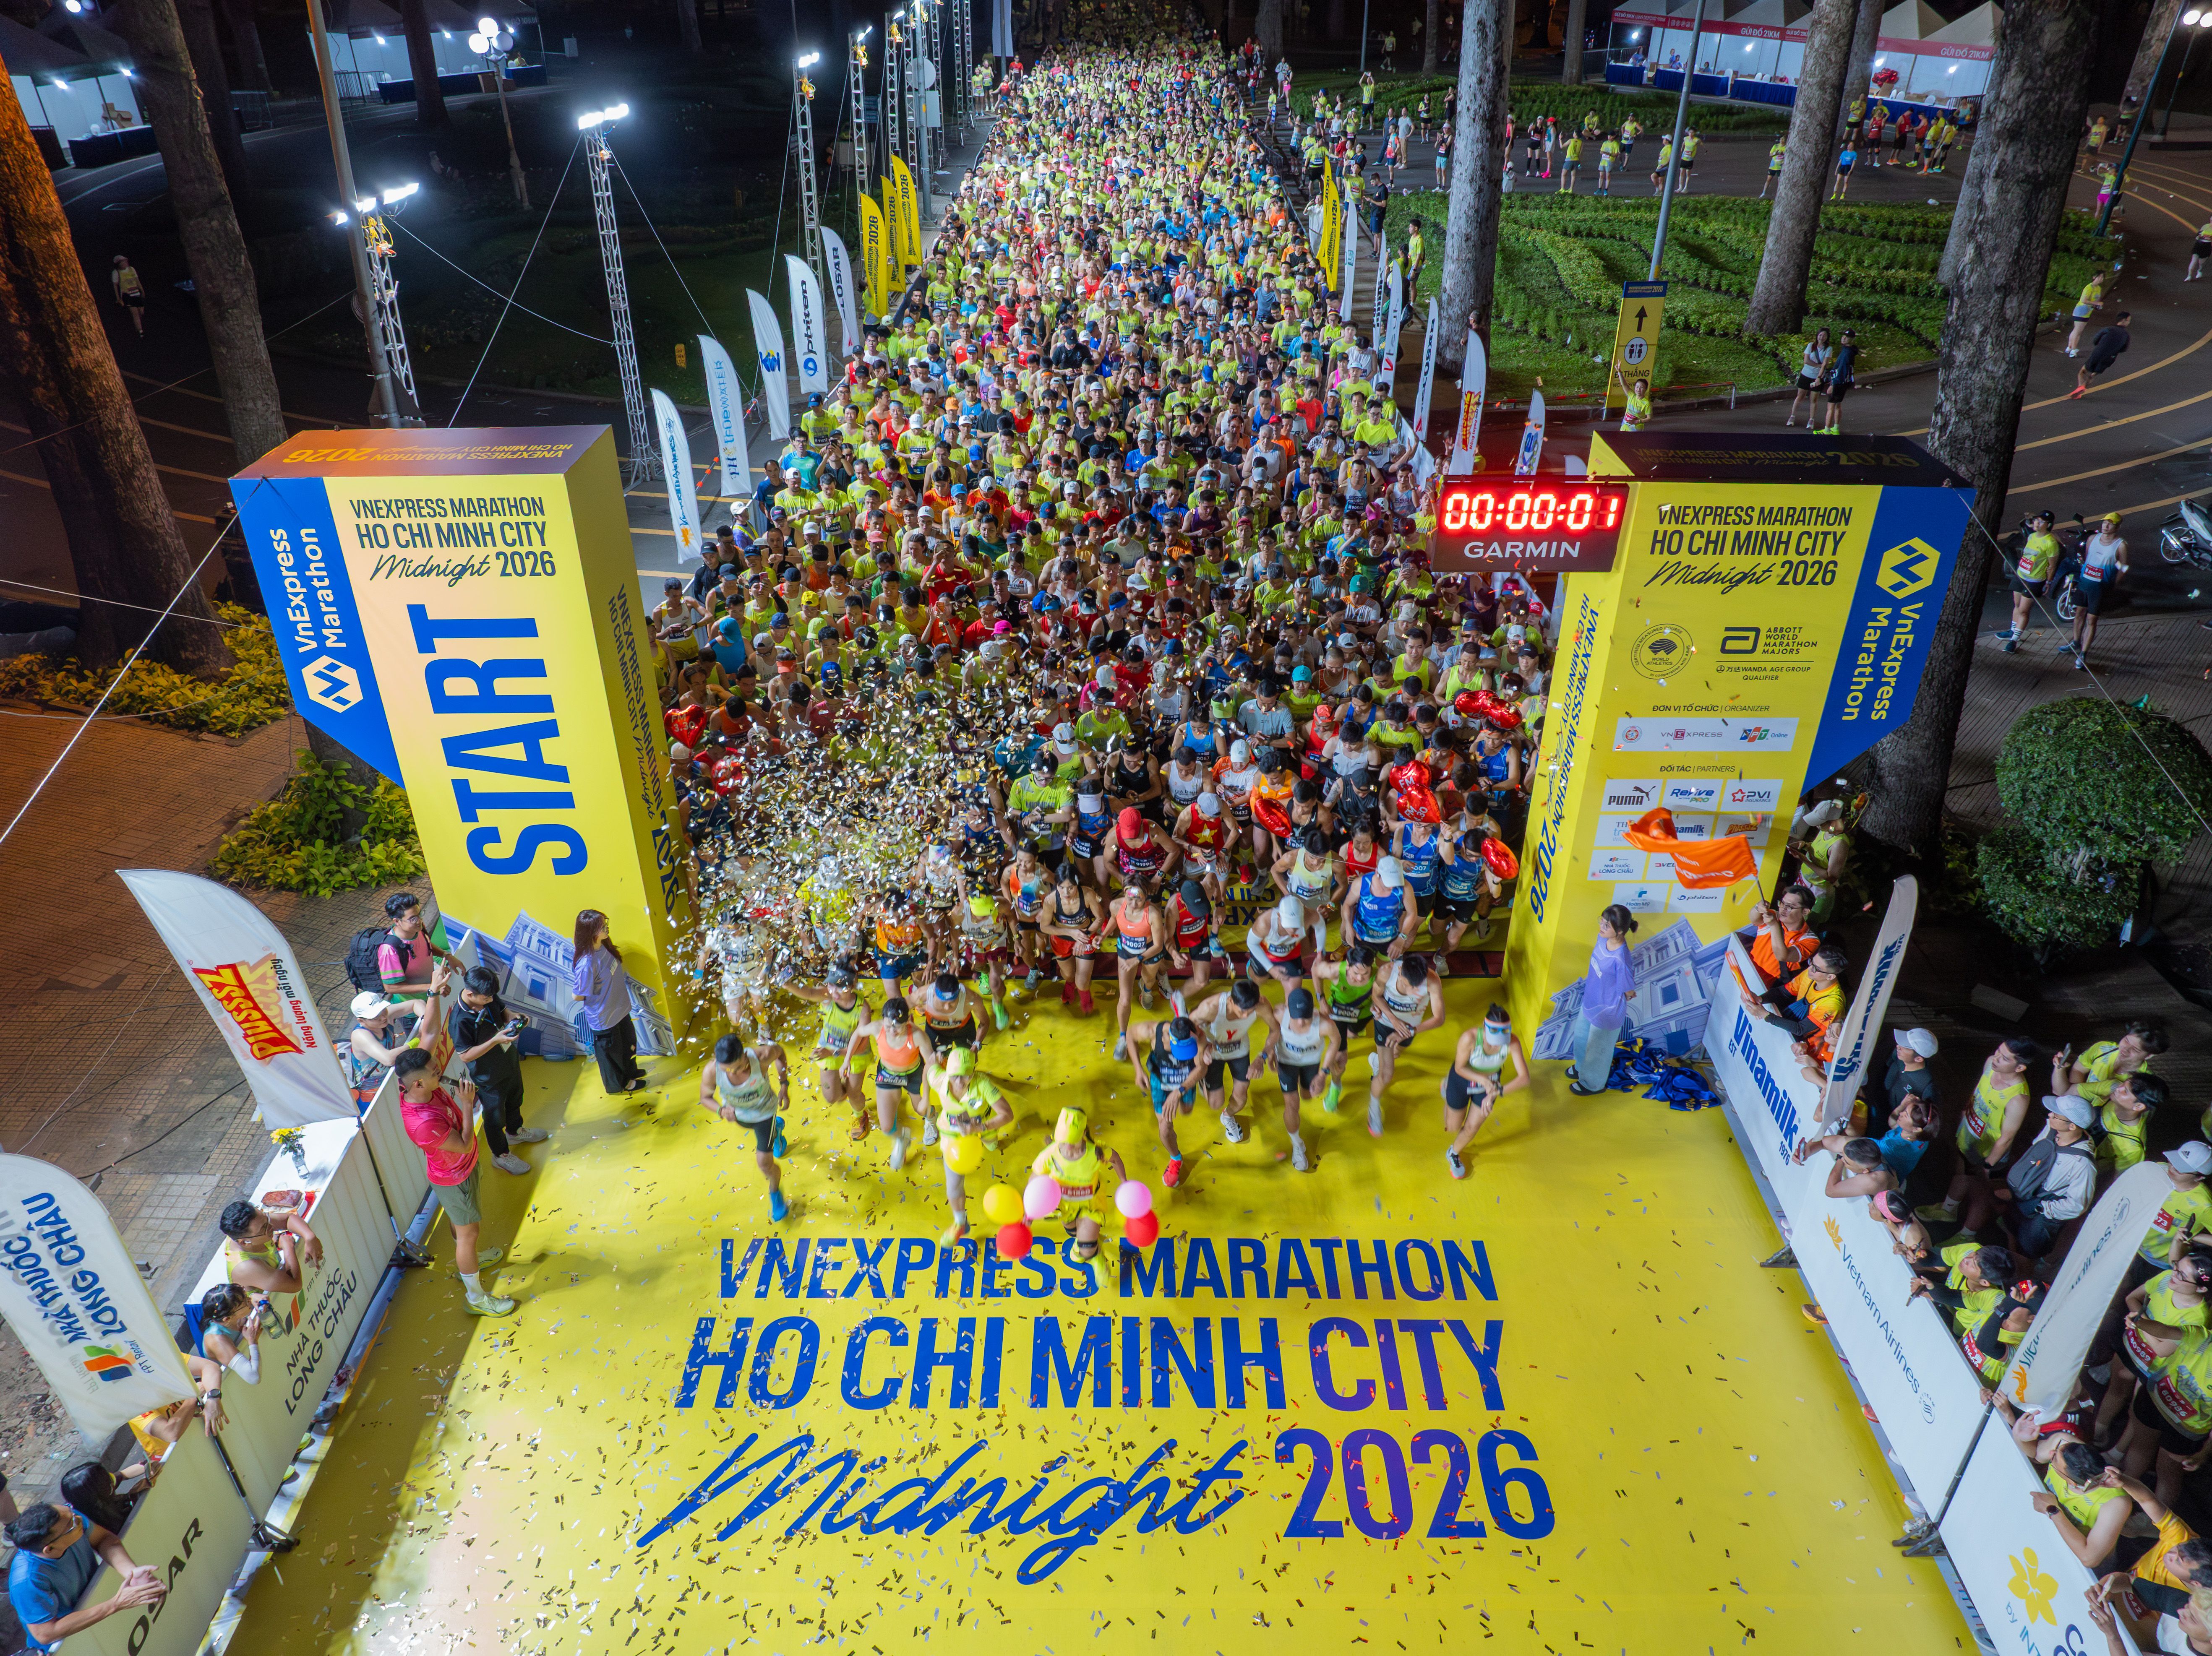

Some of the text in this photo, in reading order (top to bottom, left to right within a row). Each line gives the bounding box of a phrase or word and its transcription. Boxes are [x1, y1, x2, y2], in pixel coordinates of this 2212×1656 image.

[1763, 30, 1780, 39] 21KM
[1968, 50, 1989, 60] 21KM
[900, 174, 910, 200] 2026
[869, 215, 878, 245] 2026
[283, 448, 563, 463] VNEXPRESS MARATHON 2026
[1826, 451, 1920, 467] 2026
[349, 497, 545, 518] VNEXPRESS MARATHON
[355, 521, 546, 548] HO CHI MINH CITY
[1444, 493, 1618, 530] 00:00:01
[1659, 505, 1853, 526] VNEXPRESS MARATHON
[370, 550, 556, 587] Midnight 2026
[1464, 542, 1581, 558] GARMIN
[1650, 529, 1847, 556] HO CHI MINH CITY
[270, 529, 318, 653] VnExpress
[300, 528, 347, 648] Marathon
[1644, 560, 1838, 595] Midnight 2026
[1562, 593, 1589, 729] HO MINH CITY
[1842, 608, 1892, 720] Marathon
[1871, 602, 1924, 720] VnExpress
[608, 596, 655, 820] HO CHI MINH CITY Midnight
[617, 583, 663, 811] VNEXPRESS MARATHON
[671, 714, 686, 723] FM
[1552, 608, 1599, 833] VNEXPRESS MARATHON
[1677, 705, 1683, 713] VỊ
[1683, 703, 1694, 712] TỔ
[407, 604, 588, 875] START
[1659, 764, 1675, 772] ĐỐI
[1398, 777, 1415, 789] FM
[1404, 805, 1416, 817] FM
[1608, 795, 1644, 805] PUMA
[652, 810, 679, 914] 2026
[1530, 816, 1556, 924] 2026
[192, 964, 305, 1060] Plusssz
[270, 959, 318, 1048] Năng lượng mỗi ngày
[1728, 1038, 1791, 1166] EST 1976
[1734, 1004, 1799, 1153] Vinamilk
[0, 1236, 91, 1344] NHÀ THUỐC
[21, 1193, 127, 1336] LONG CHÂU
[719, 1237, 1498, 1301] VNEXPRESS MARATHON
[285, 1270, 357, 1416] LONG CHÂU
[286, 1268, 342, 1377] NHÀ THUỐC
[1842, 1243, 1920, 1394] Vietnam Airlines
[124, 1340, 154, 1374] FPT Retail
[674, 1315, 1505, 1412] HO CHI MINH CITY
[637, 1429, 1555, 1586] Midnight 2026
[2006, 1601, 2018, 1623] by
